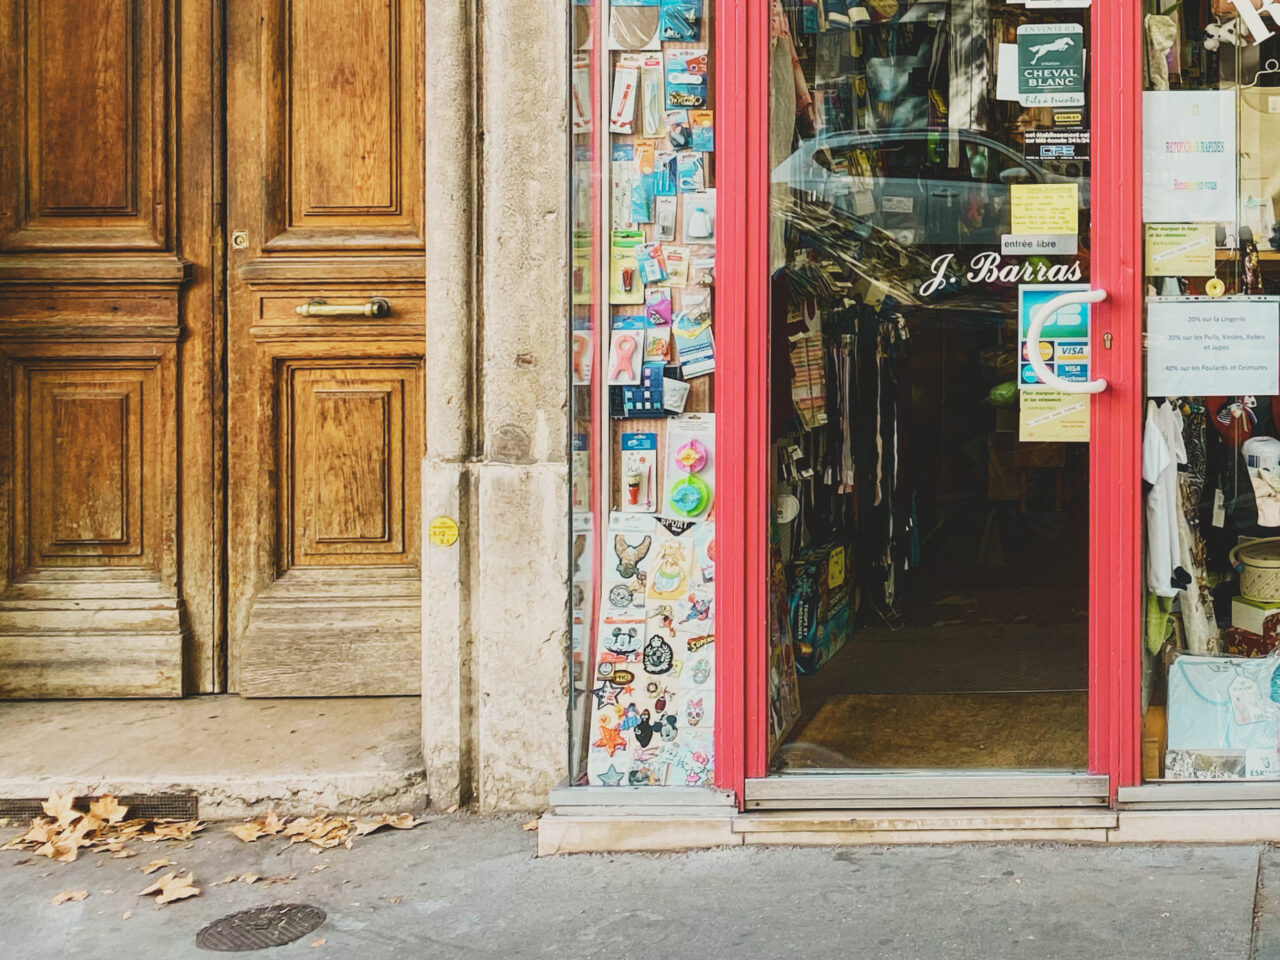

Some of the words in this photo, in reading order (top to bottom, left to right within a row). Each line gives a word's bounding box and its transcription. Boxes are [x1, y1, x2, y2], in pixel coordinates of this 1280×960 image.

[1024, 68, 1078, 78] CHEVAL
[1028, 77, 1075, 87] BLANC
[1025, 95, 1041, 105] Fils
[1004, 239, 1033, 248] entrée
[1036, 239, 1057, 248] libre
[919, 253, 957, 296] J.
[966, 252, 1082, 284] Barras
[1221, 316, 1246, 324] Lingerie
[1061, 346, 1084, 355] VISA
[1212, 344, 1230, 352] Jupes
[660, 517, 689, 529] SPORT
